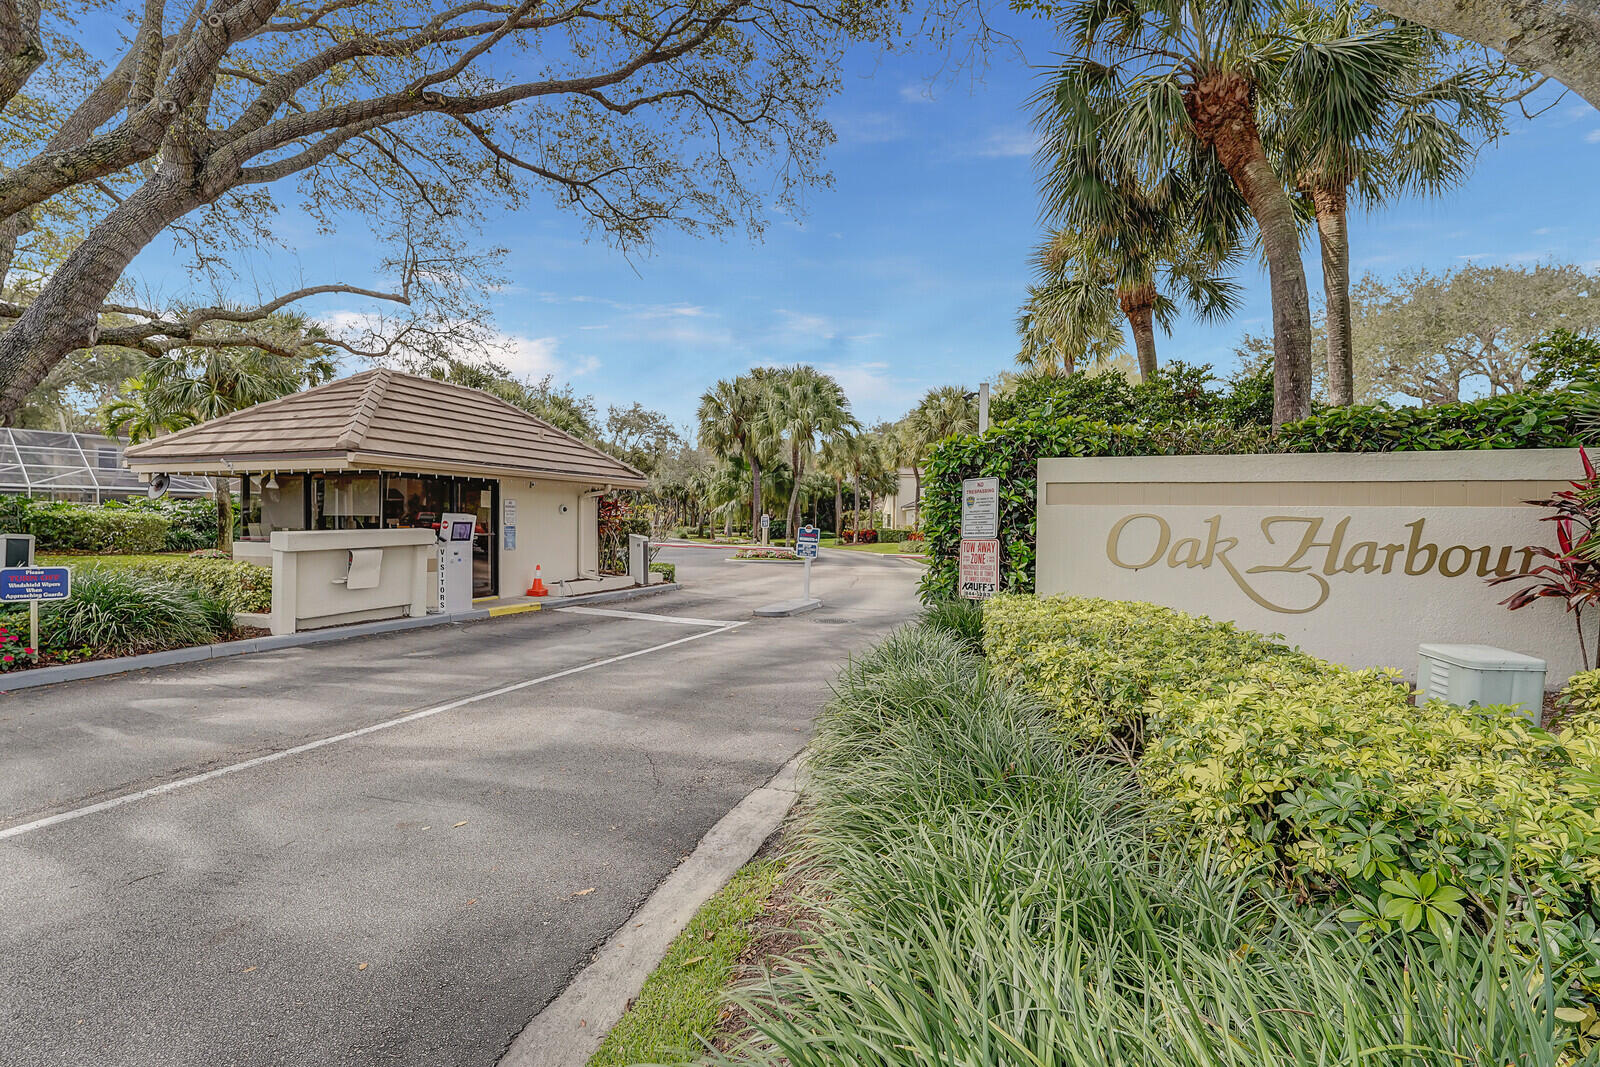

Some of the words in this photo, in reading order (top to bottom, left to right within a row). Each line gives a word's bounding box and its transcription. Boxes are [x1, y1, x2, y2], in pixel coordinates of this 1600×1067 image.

[963, 542, 975, 552] TOW
[977, 542, 996, 553] AWAY
[970, 553, 986, 564] ZONE
[1106, 513, 1330, 614] Oak
[1246, 515, 1537, 577] Harbour
[962, 582, 996, 592] KAUFF'S
